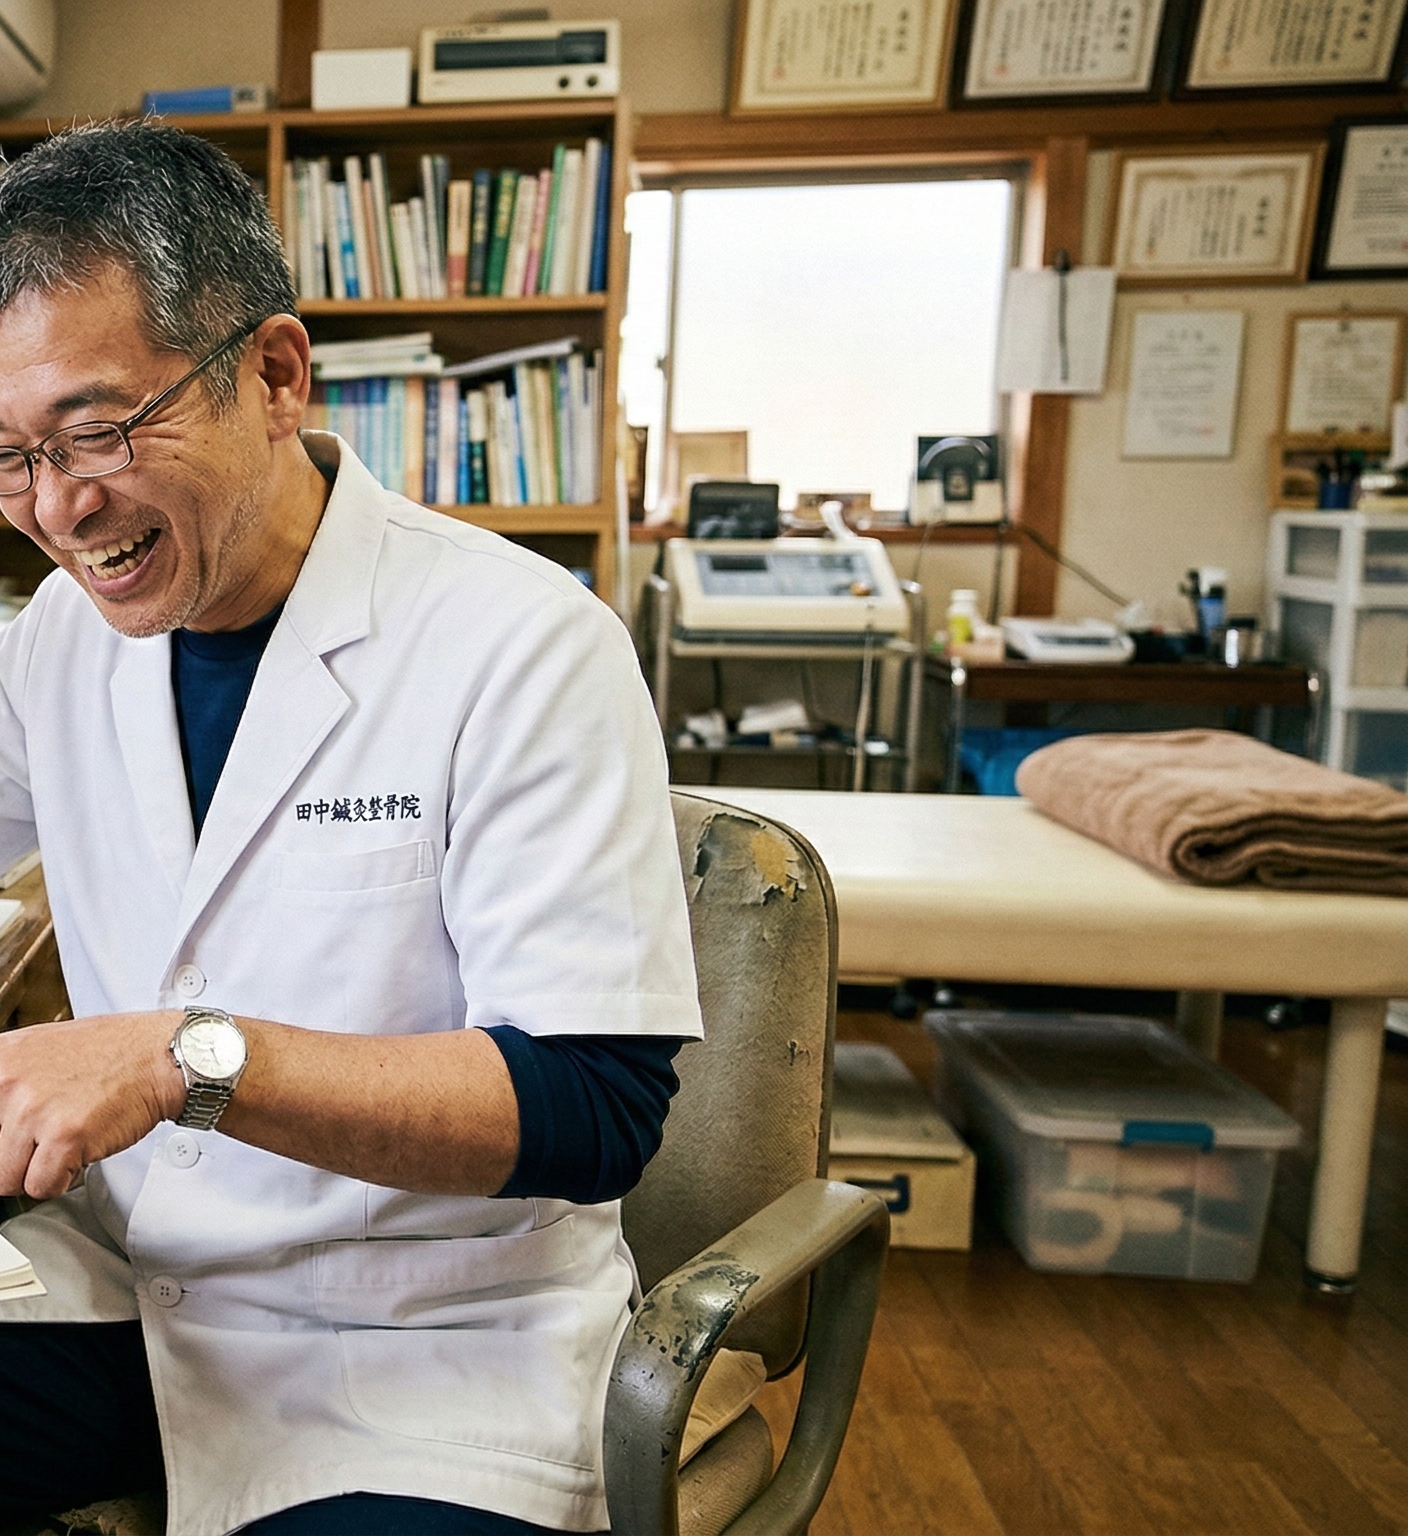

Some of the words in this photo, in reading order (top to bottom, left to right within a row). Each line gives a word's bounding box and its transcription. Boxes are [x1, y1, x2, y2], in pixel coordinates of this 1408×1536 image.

[296, 793, 421, 824] 田中鍼灸整骨院
